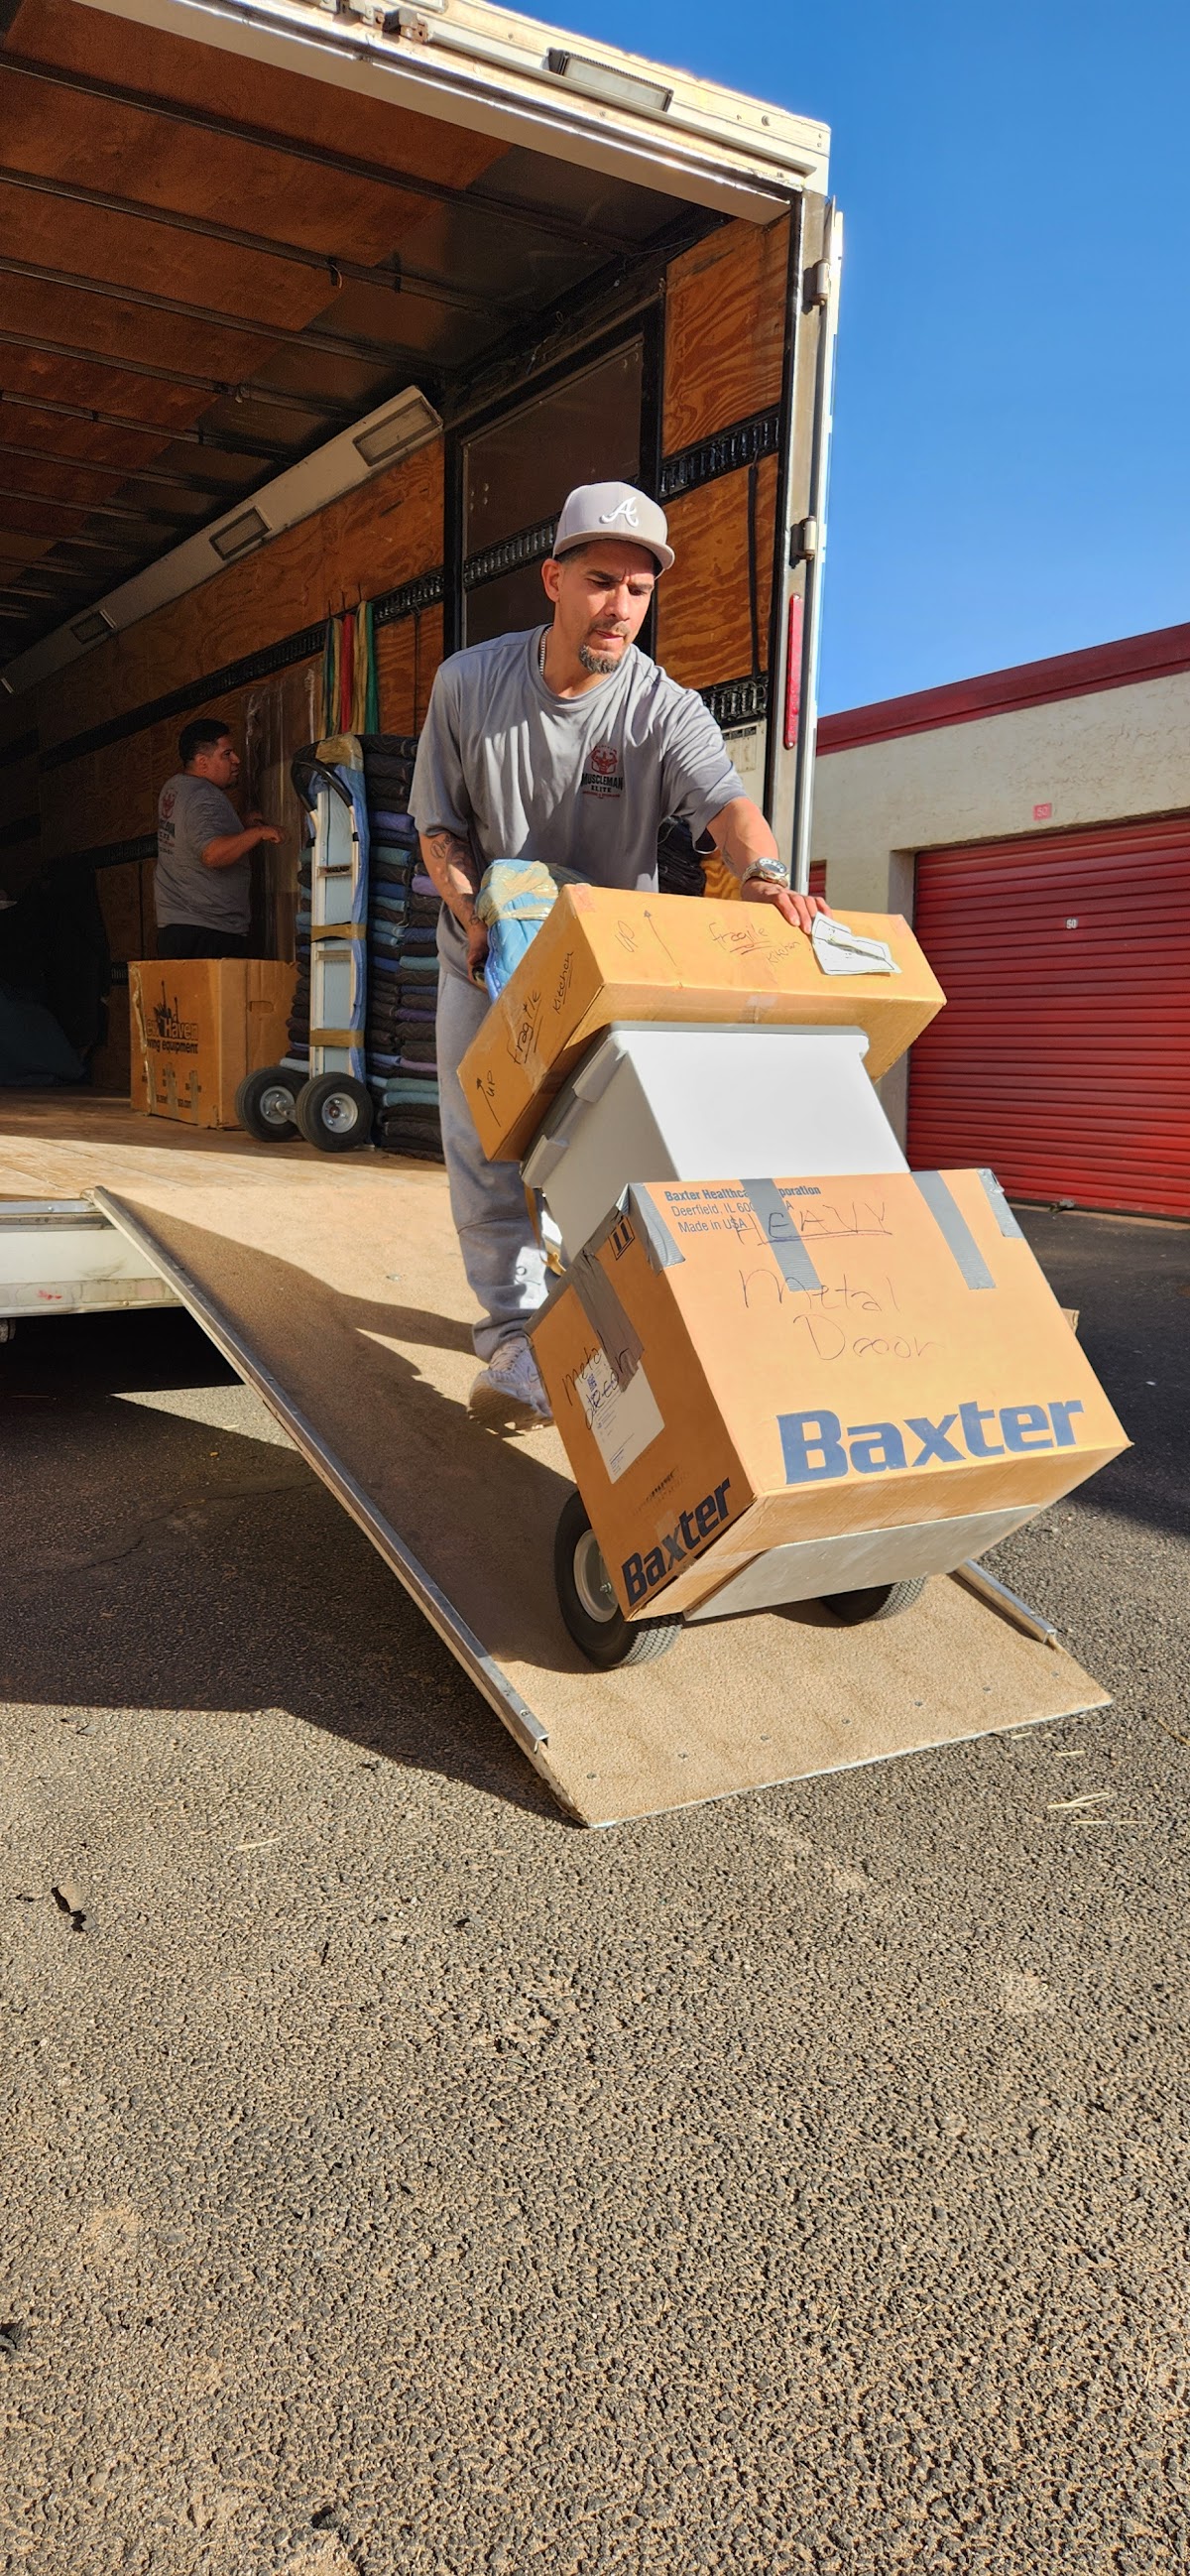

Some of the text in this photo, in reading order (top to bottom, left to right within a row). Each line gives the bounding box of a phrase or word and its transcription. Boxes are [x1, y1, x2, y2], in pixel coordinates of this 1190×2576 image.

[599, 496, 640, 528] A
[580, 773, 624, 791] MUSCLEMAN
[164, 1018, 198, 1042] Haven
[162, 1041, 198, 1054] equipment
[664, 1185, 822, 1202] Baxter Healthca poration
[724, 1202, 736, 1214] IL
[677, 1220, 709, 1233] Made
[711, 1219, 722, 1231] in
[730, 1201, 892, 1246] HEAVY
[775, 1400, 1084, 1485] Baxter
[621, 1476, 731, 1607] Baxter
